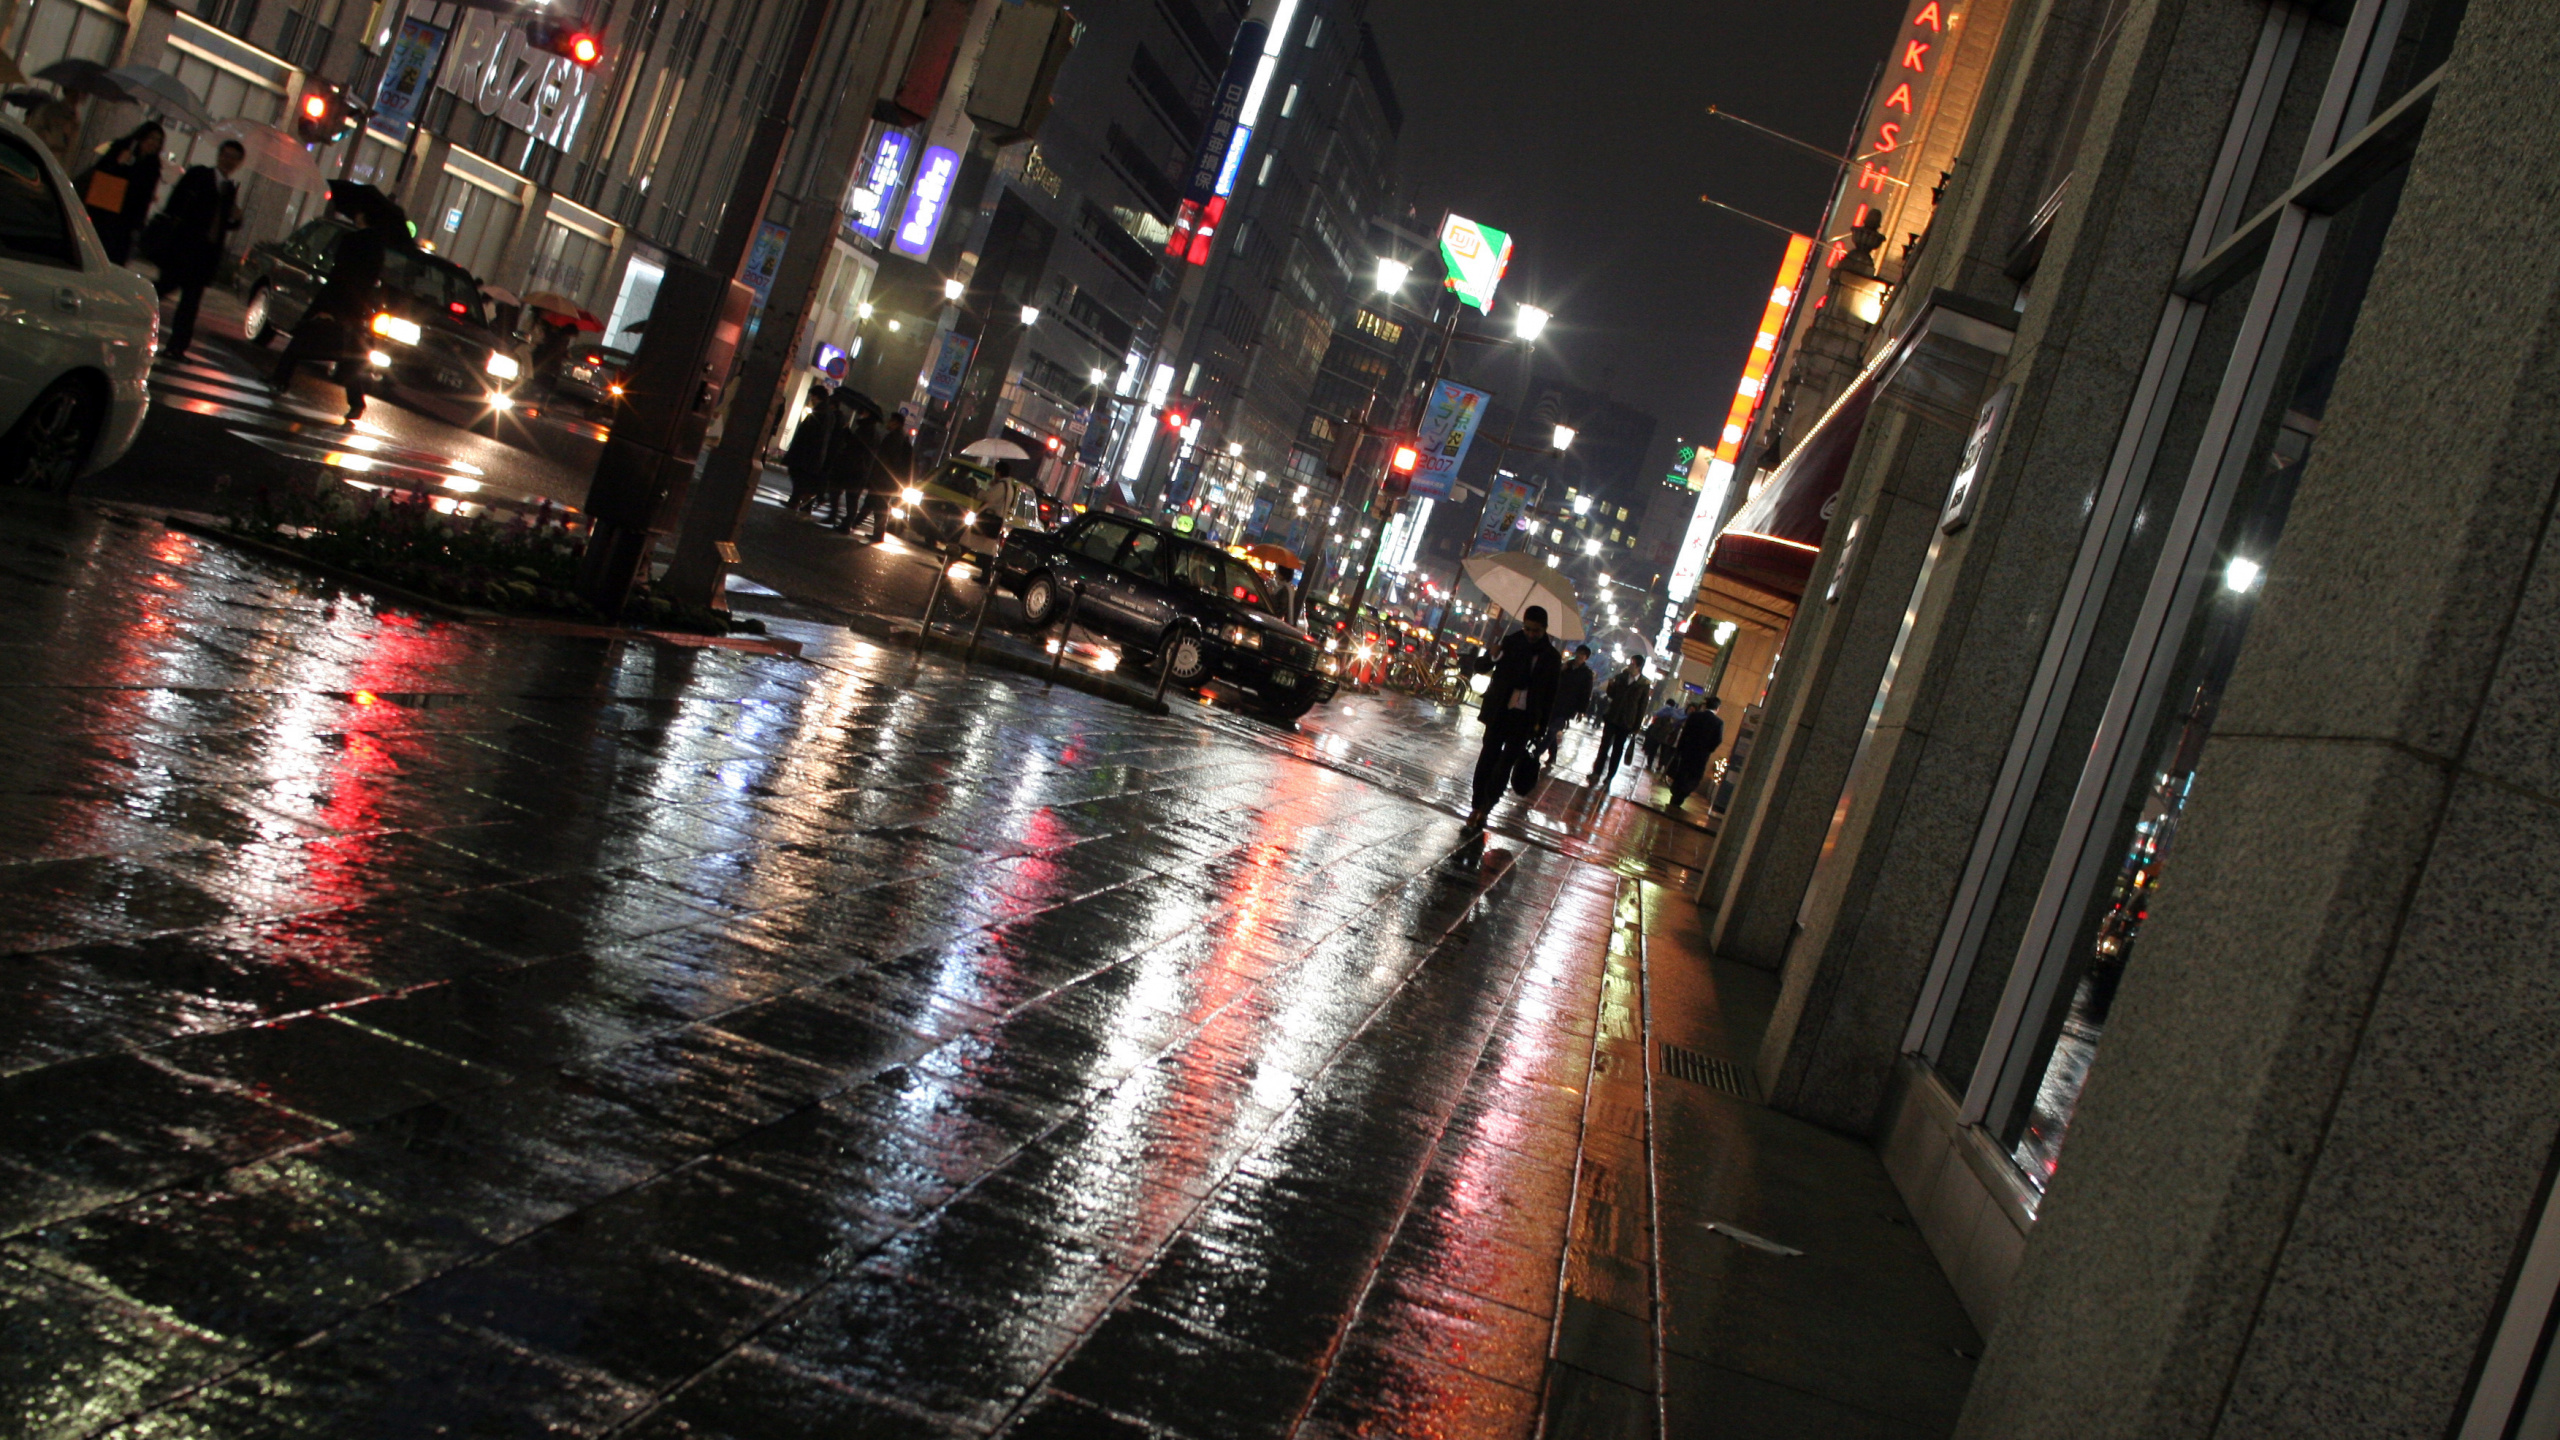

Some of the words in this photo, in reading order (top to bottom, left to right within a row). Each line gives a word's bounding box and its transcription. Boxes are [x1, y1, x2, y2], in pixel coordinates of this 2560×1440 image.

[381, 91, 410, 109] 007
[1195, 84, 1243, 191] 日本興亜損保
[1815, 0, 1938, 309] AKASHI
[902, 156, 951, 246] Berlitz
[1424, 386, 1461, 453] マラソン
[1418, 455, 1454, 473] 2007
